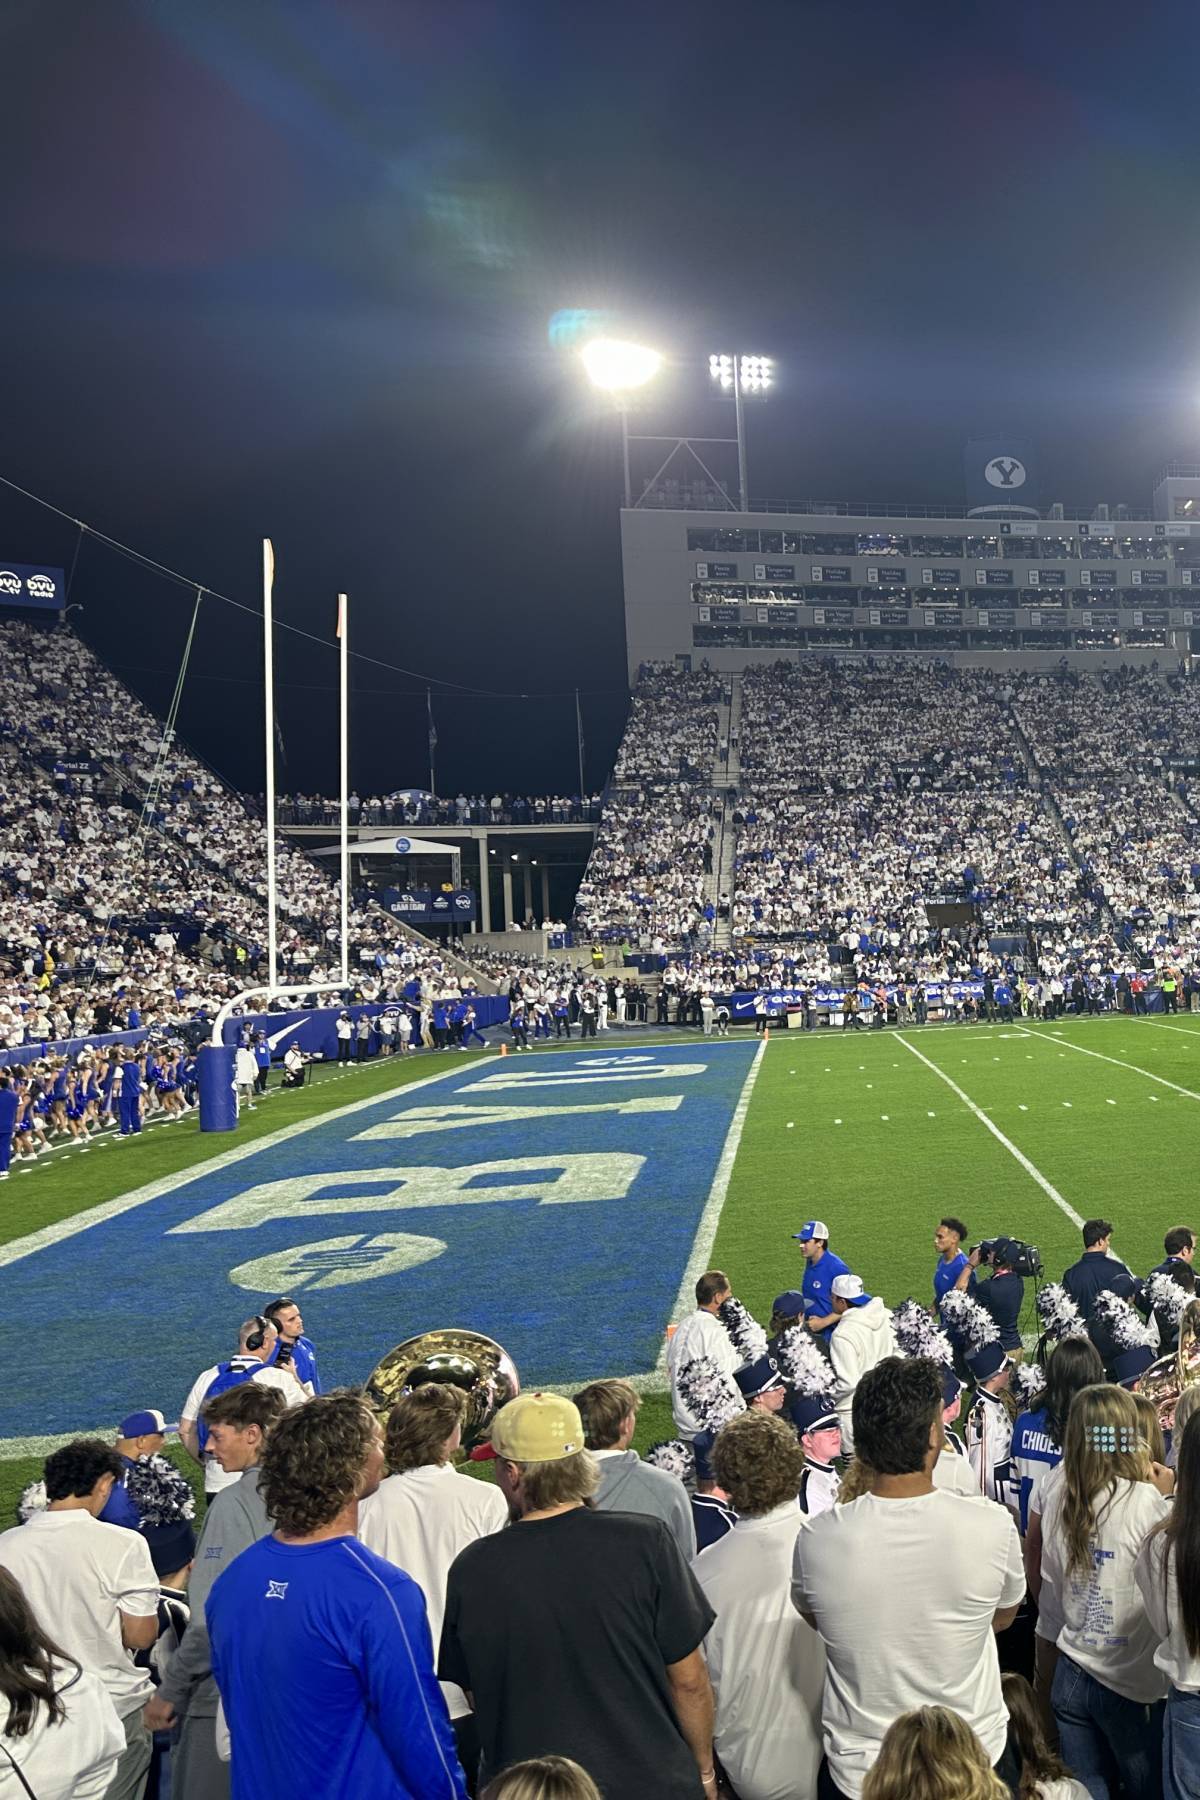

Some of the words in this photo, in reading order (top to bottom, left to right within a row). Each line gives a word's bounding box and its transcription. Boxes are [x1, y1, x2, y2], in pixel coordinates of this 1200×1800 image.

[26, 579, 56, 592] byu
[29, 590, 54, 599] radio
[164, 1063, 709, 1235] BYU
